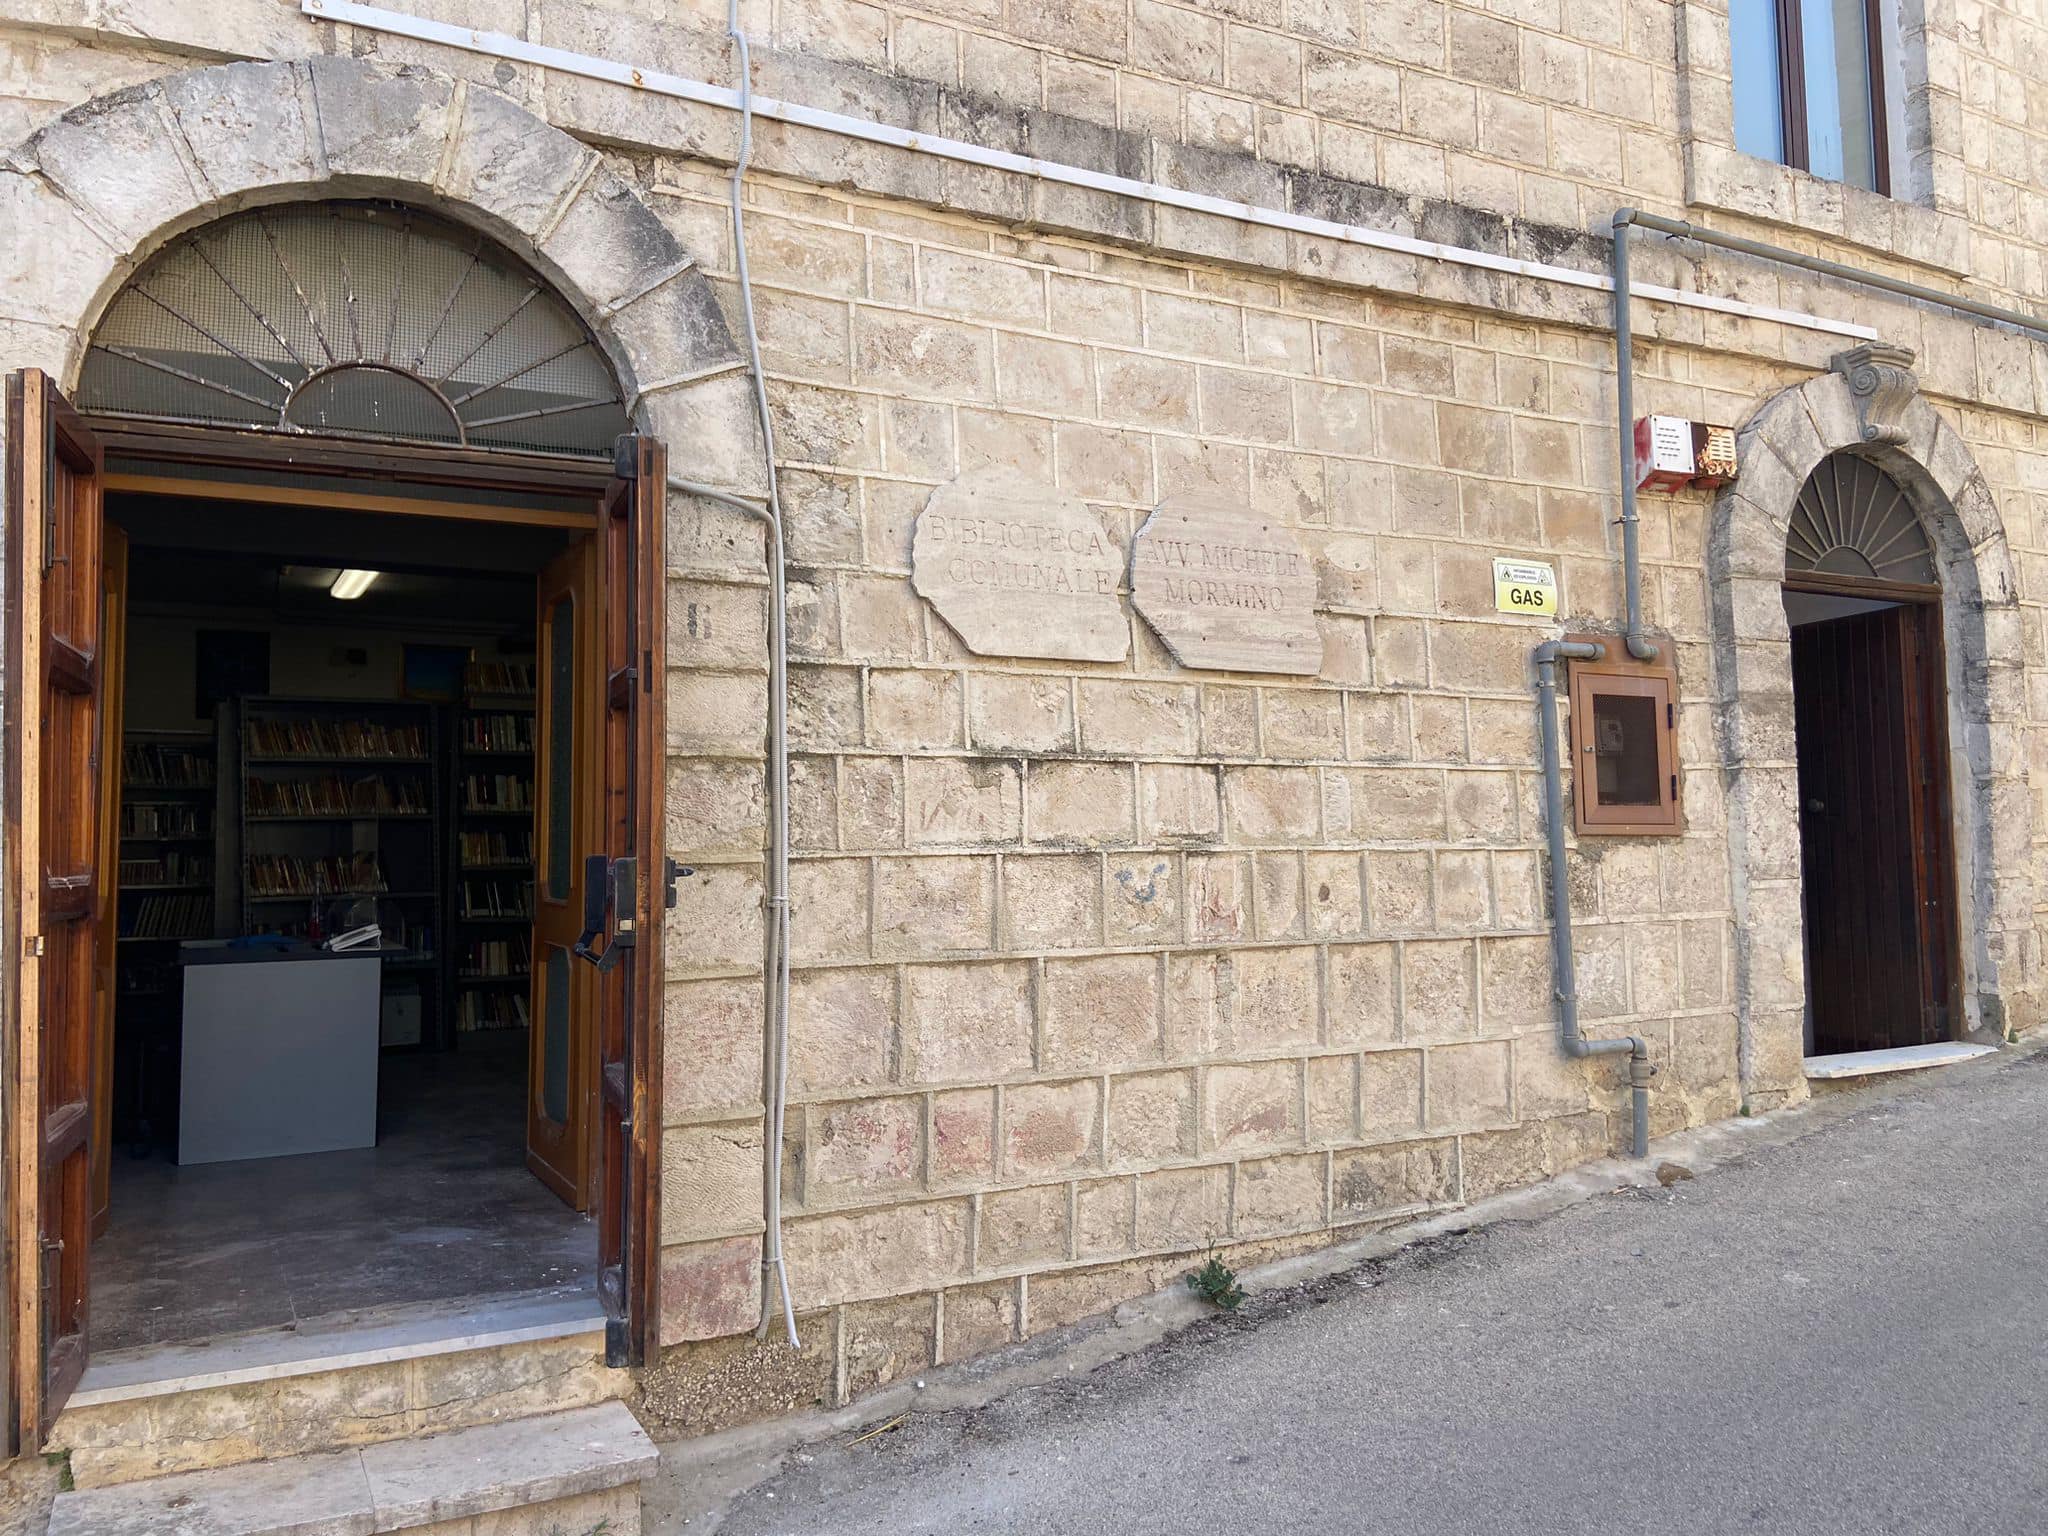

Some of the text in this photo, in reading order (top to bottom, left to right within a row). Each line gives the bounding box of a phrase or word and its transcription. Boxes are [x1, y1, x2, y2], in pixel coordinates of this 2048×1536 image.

[929, 515, 1104, 556] BIBLIOTECA
[948, 558, 1113, 594] COMUNALE
[1145, 539, 1299, 577] AVV. MICHELE
[1164, 577, 1283, 611] MORMINO
[1511, 588, 1544, 606] GAS
